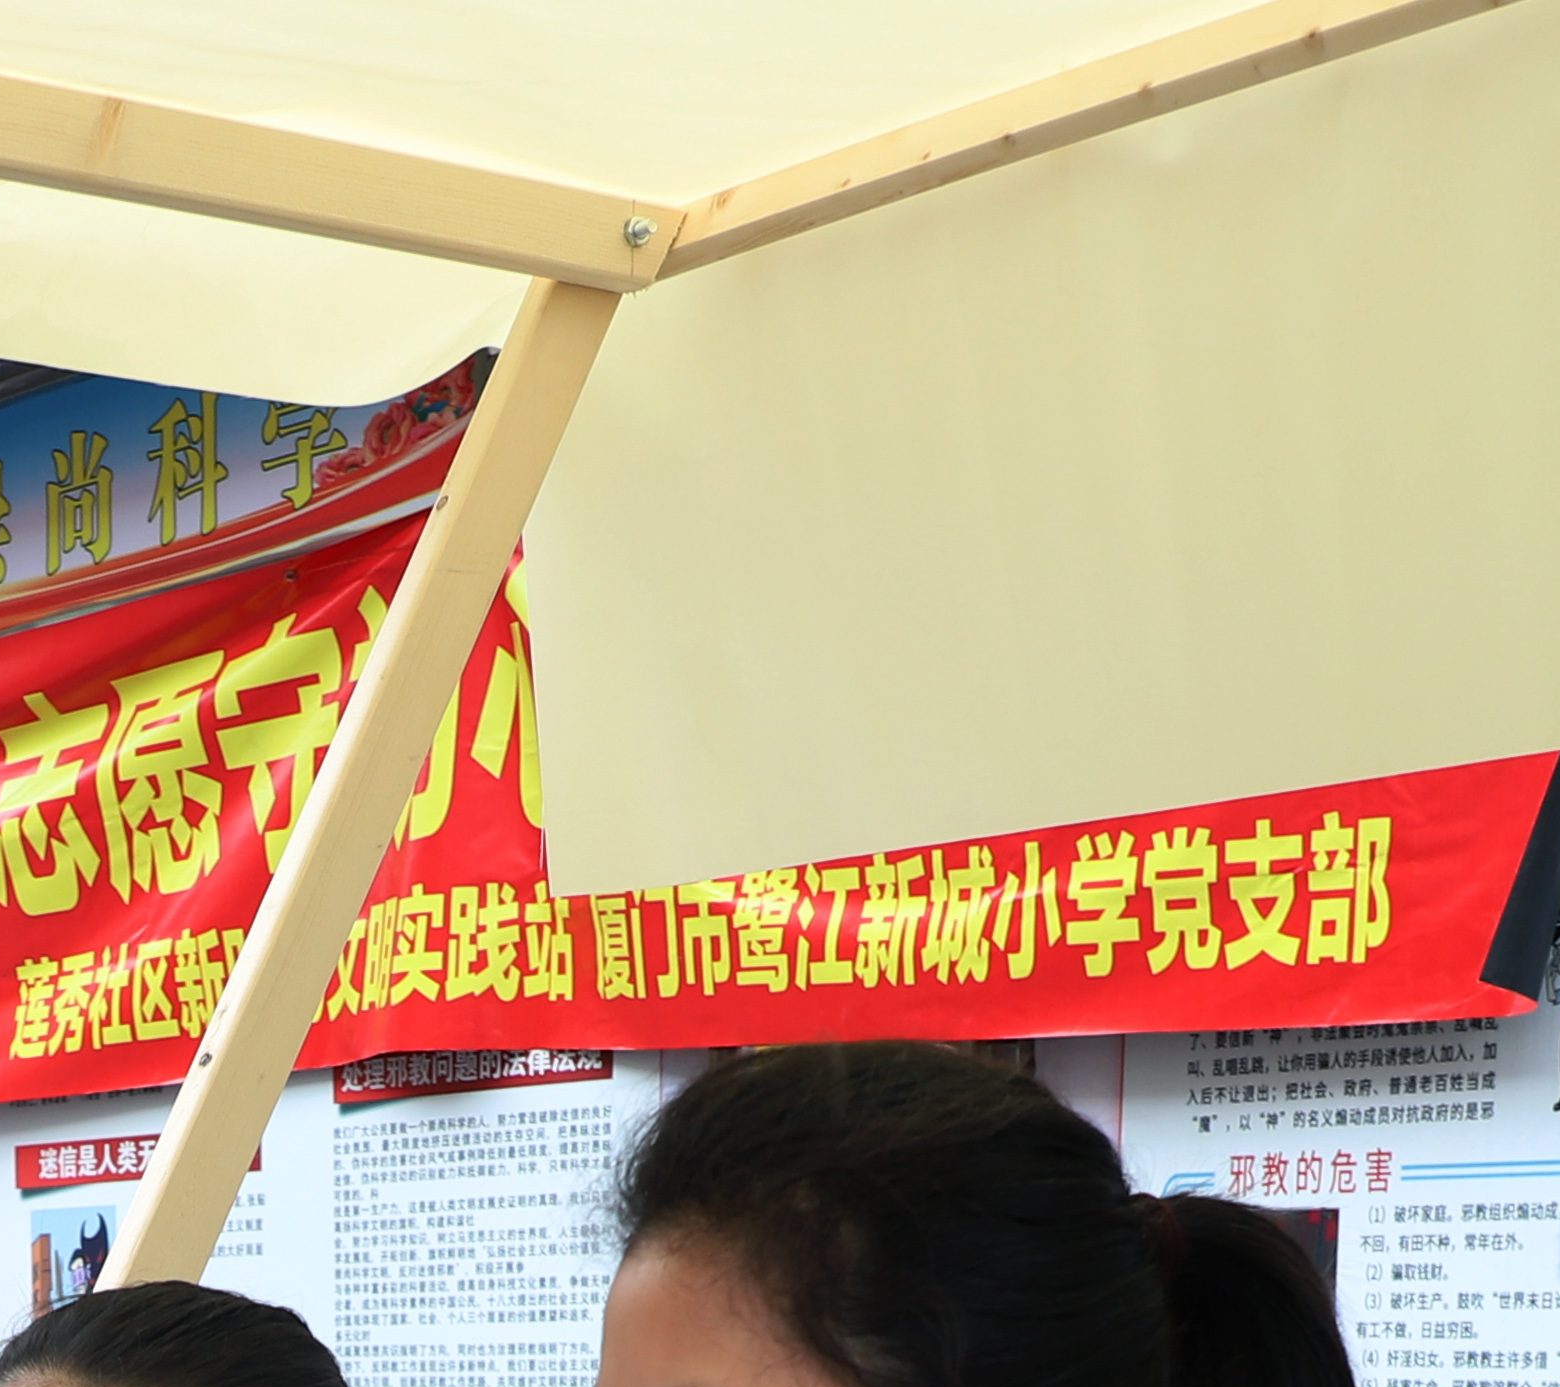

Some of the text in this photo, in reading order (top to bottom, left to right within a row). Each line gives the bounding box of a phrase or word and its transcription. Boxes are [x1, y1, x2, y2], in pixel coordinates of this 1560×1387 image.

[9, 880, 574, 1060] 莲秀社区新文明实践站
[1228, 1147, 1393, 1197] 邪教的危害
